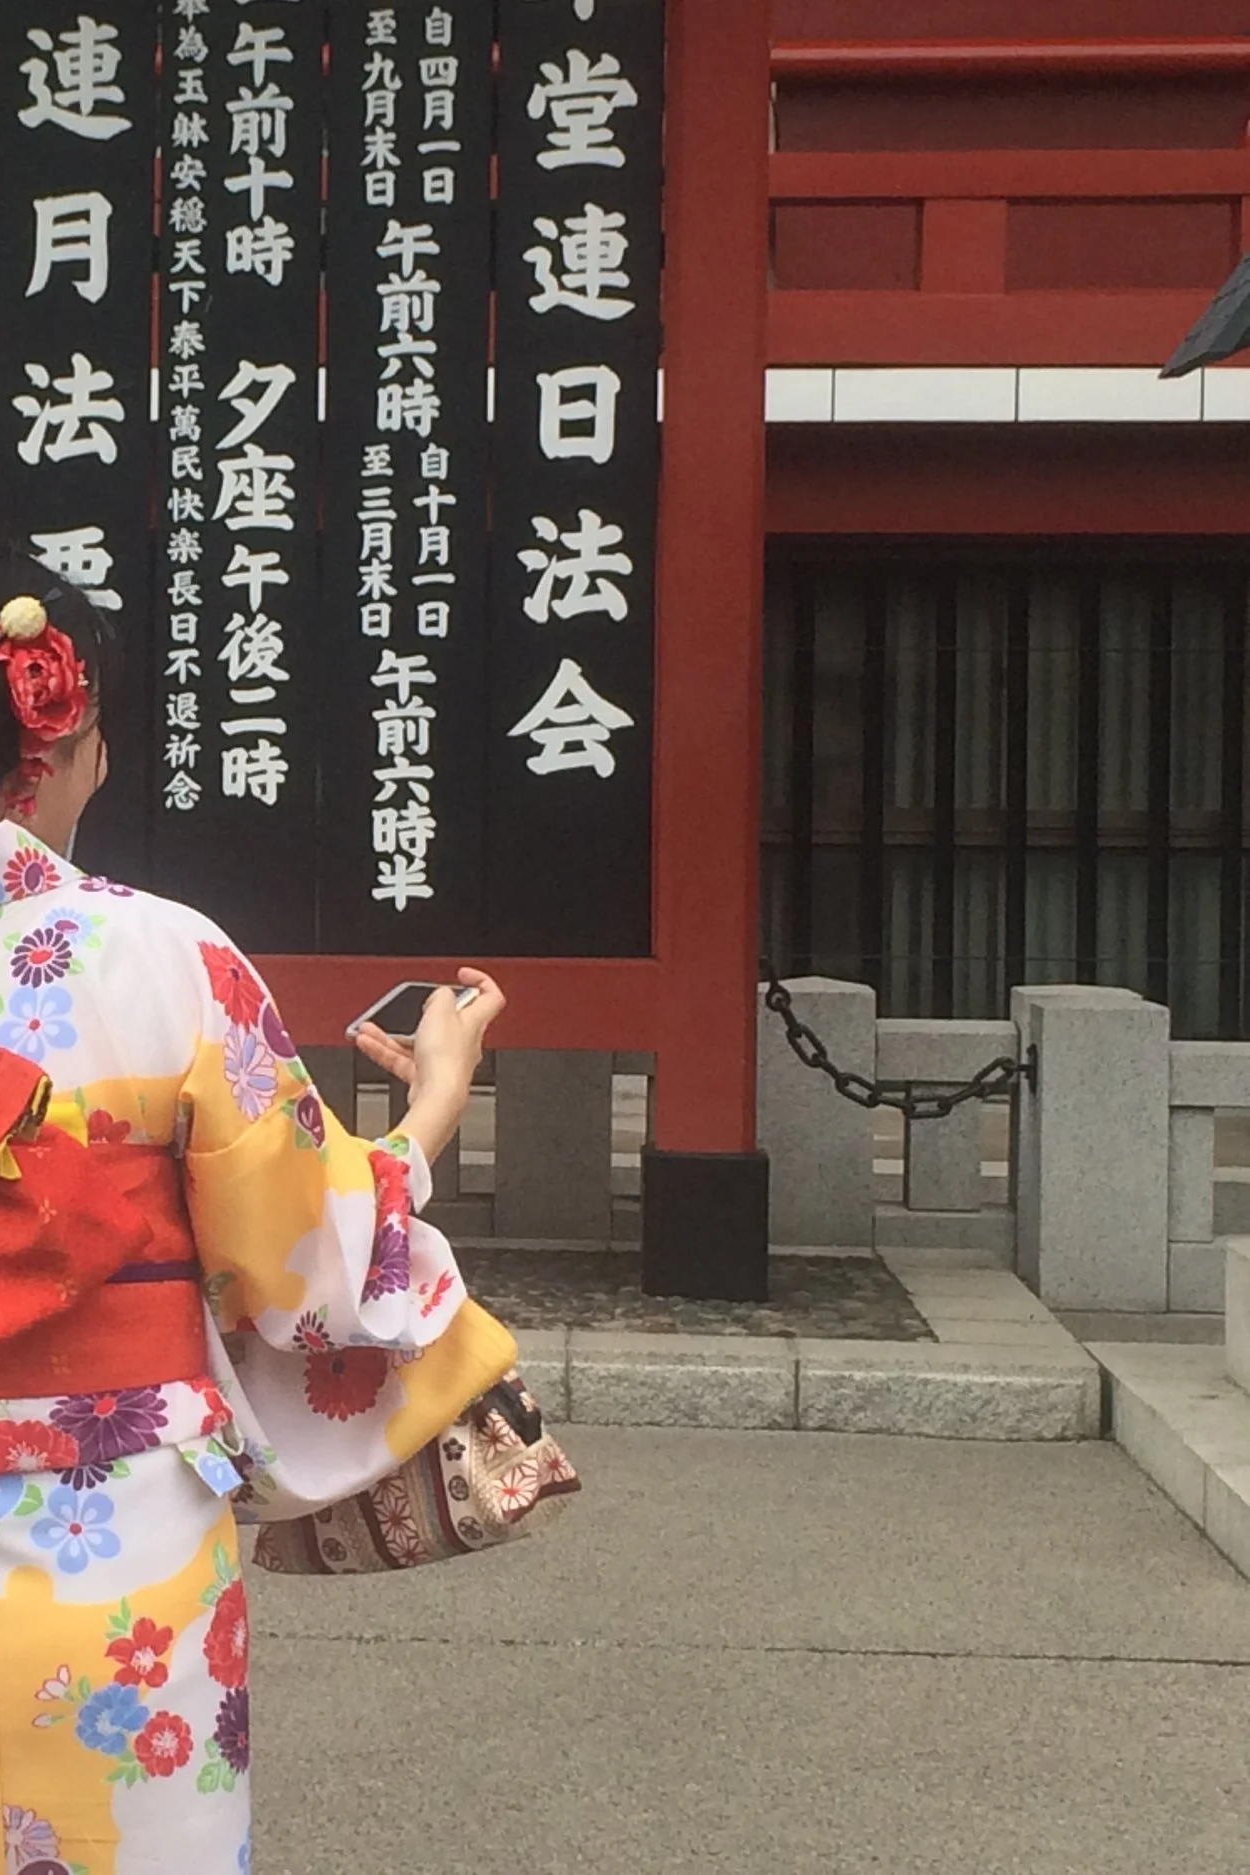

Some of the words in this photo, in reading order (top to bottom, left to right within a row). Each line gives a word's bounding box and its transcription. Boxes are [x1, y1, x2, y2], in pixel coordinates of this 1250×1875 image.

[224, 0, 294, 285] 午前十時
[362, 10, 402, 206] 至九月末日
[418, 7, 460, 203] 自四月一日
[377, 220, 441, 437] 午前六時
[507, 0, 637, 778] 堂連日法会
[357, 444, 397, 637] 至三月末日
[412, 443, 456, 637] 自十月一日
[371, 649, 436, 911] 午前六時半
